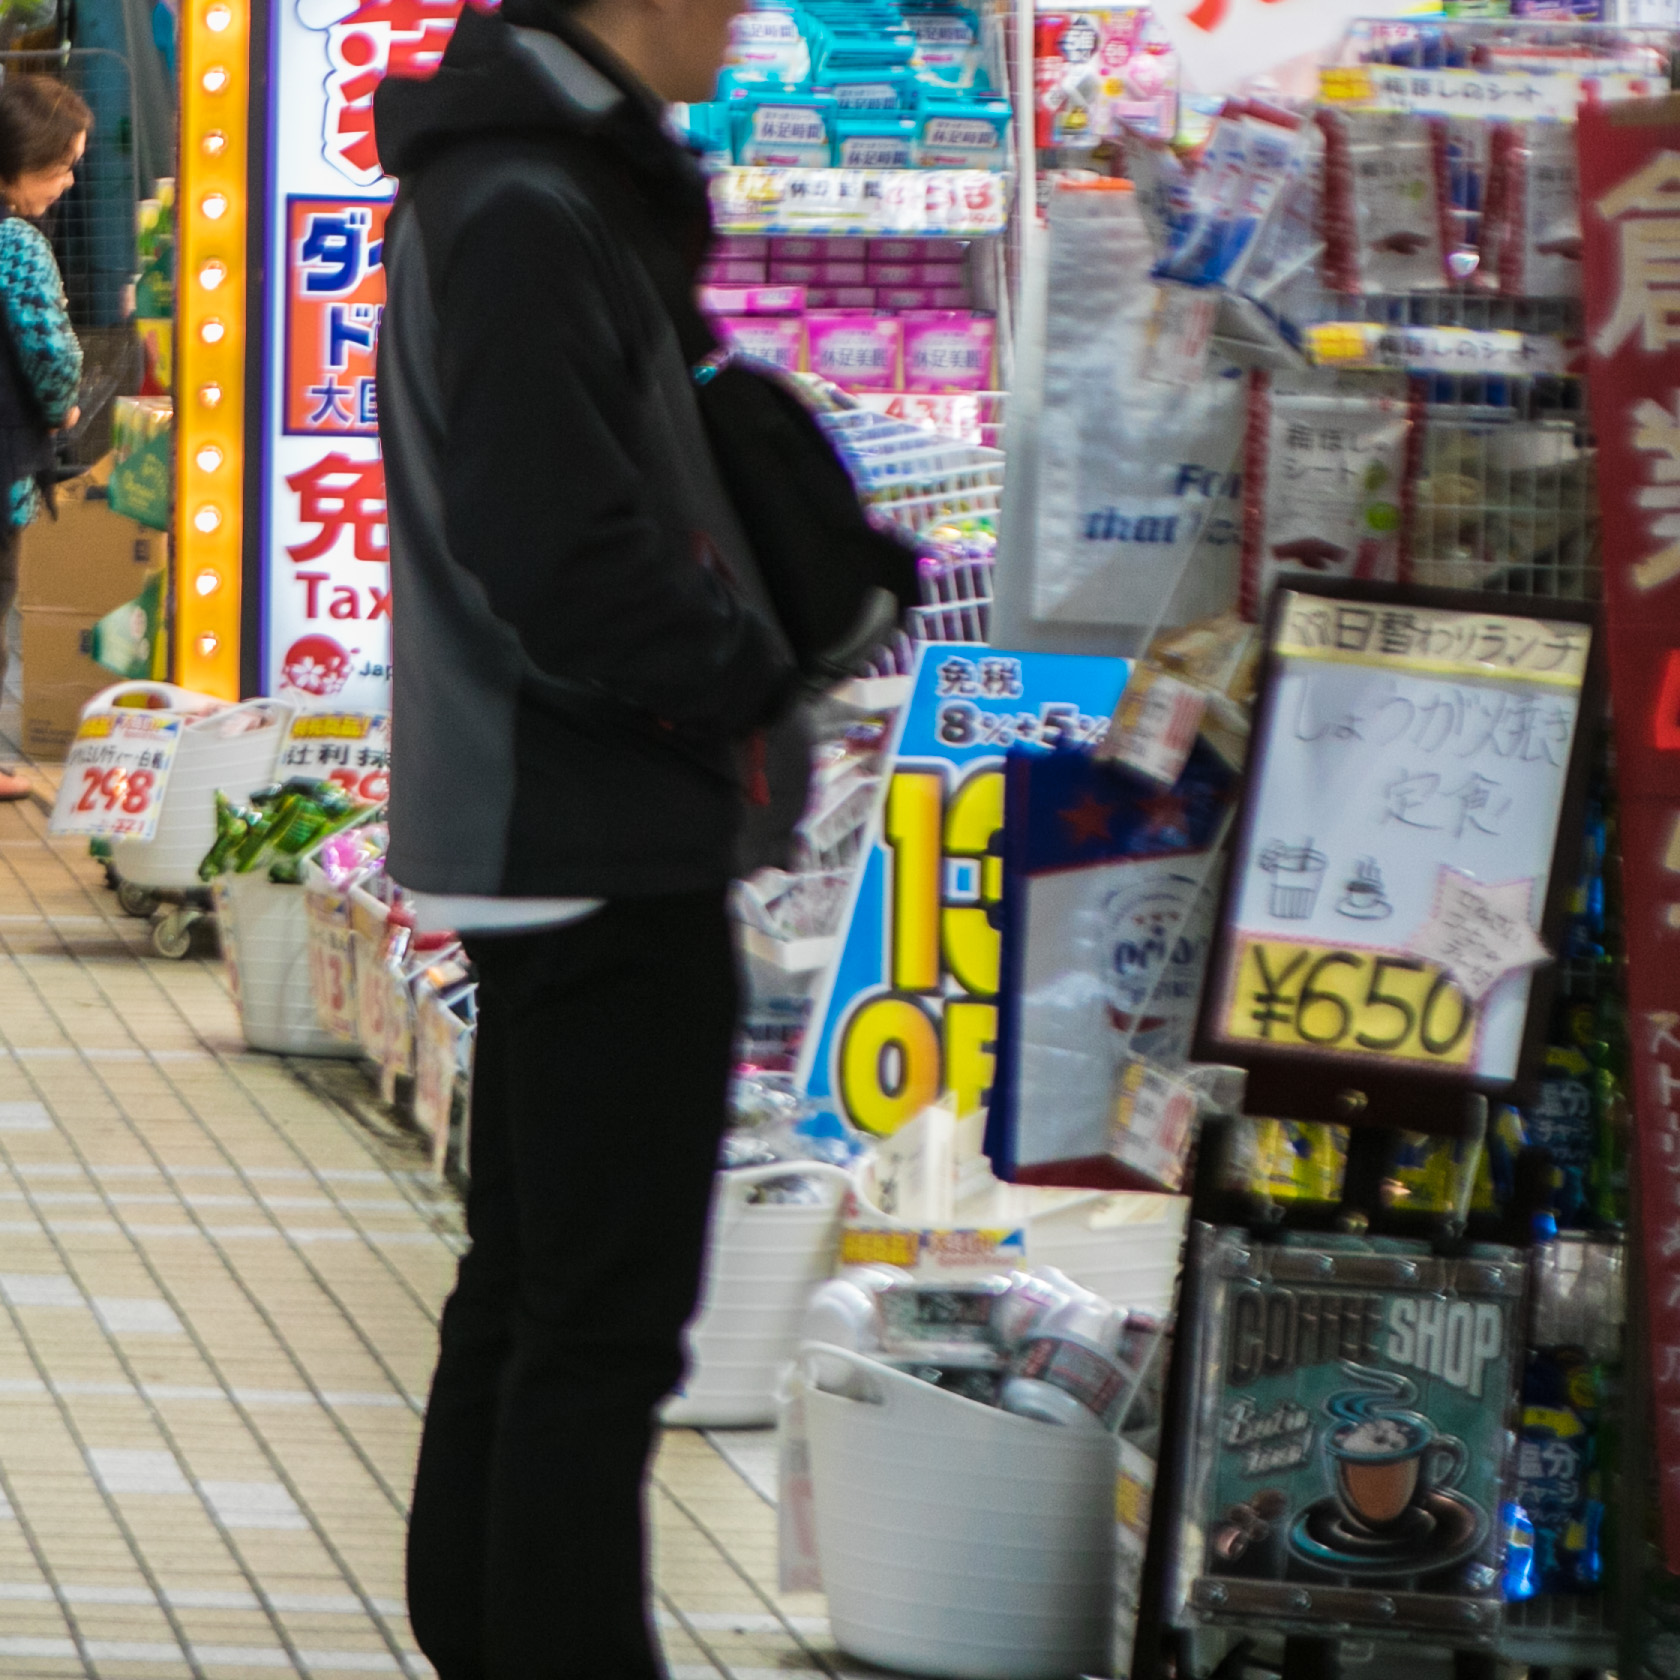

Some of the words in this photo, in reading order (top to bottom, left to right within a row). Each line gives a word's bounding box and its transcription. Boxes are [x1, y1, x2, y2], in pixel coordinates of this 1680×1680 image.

[937, 658, 1023, 697] 免税
[1250, 940, 1469, 1057] ¥650
[1386, 1297, 1503, 1398] SHOP
